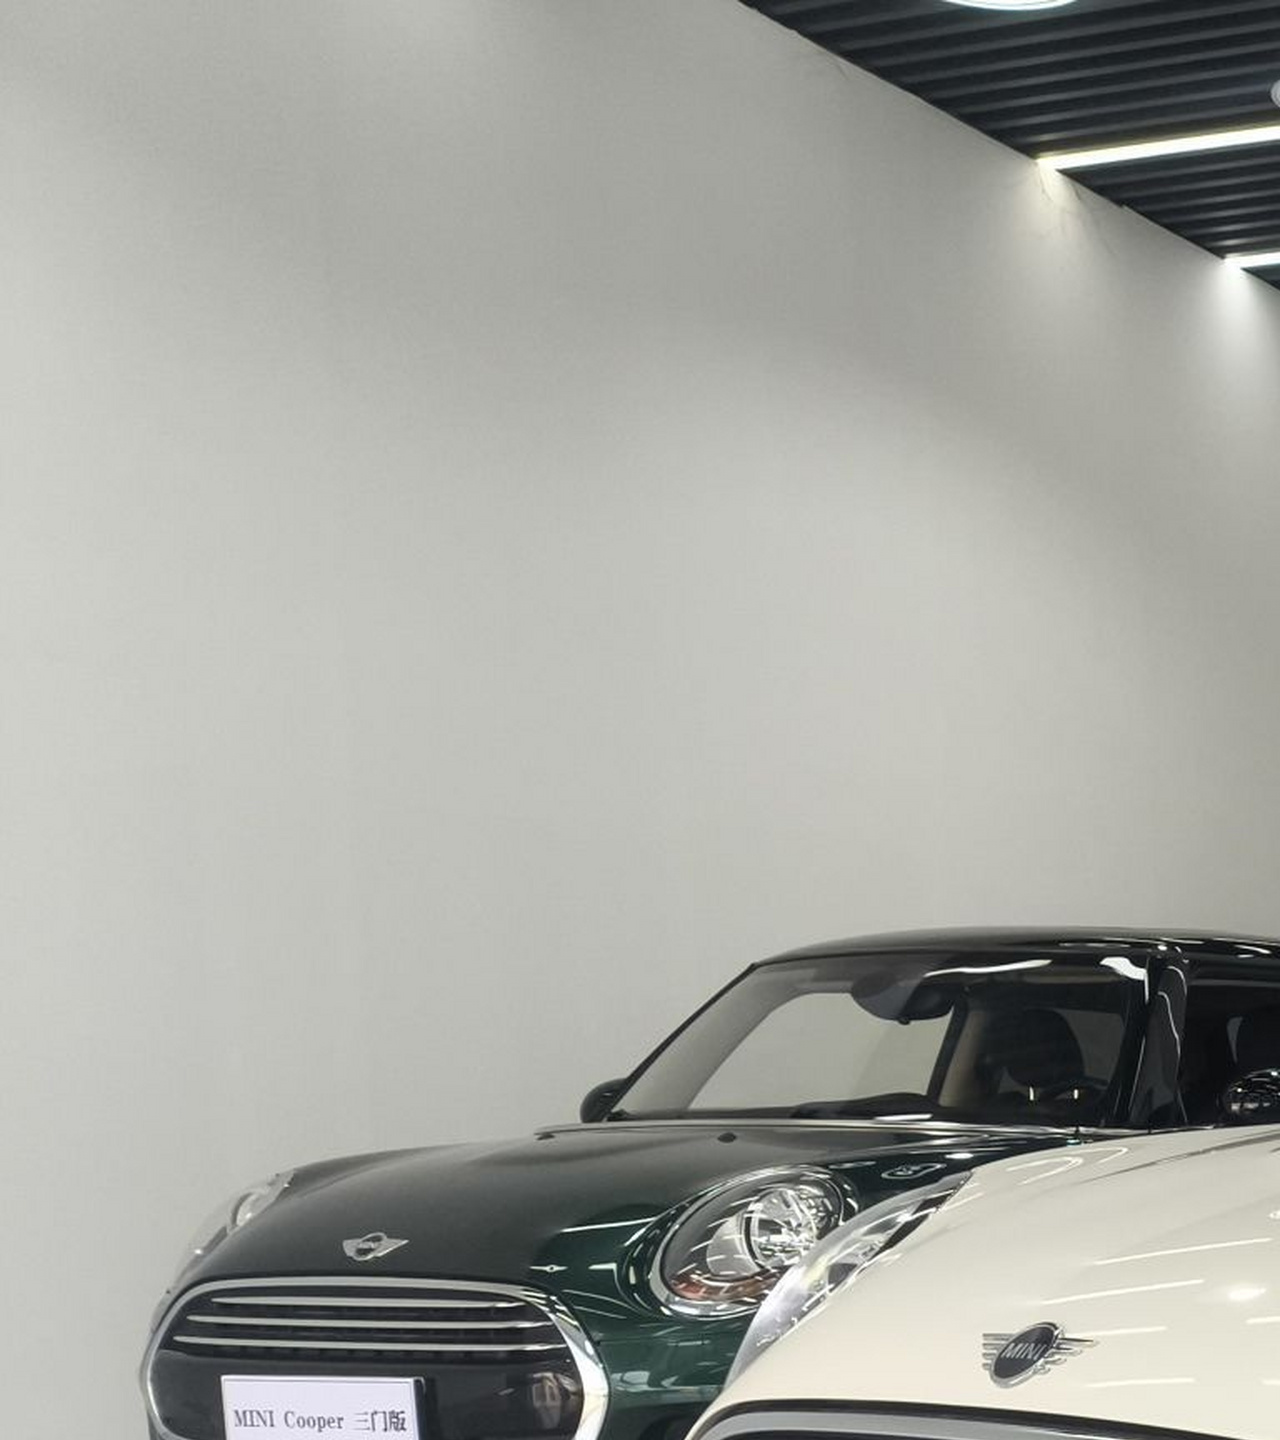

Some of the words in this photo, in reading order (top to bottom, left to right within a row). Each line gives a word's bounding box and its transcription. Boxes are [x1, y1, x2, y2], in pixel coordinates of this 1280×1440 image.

[1001, 1342, 1047, 1360] MINI
[234, 1409, 275, 1428] MINI
[284, 1410, 344, 1432] Cooper
[353, 1410, 407, 1432] 三门版
